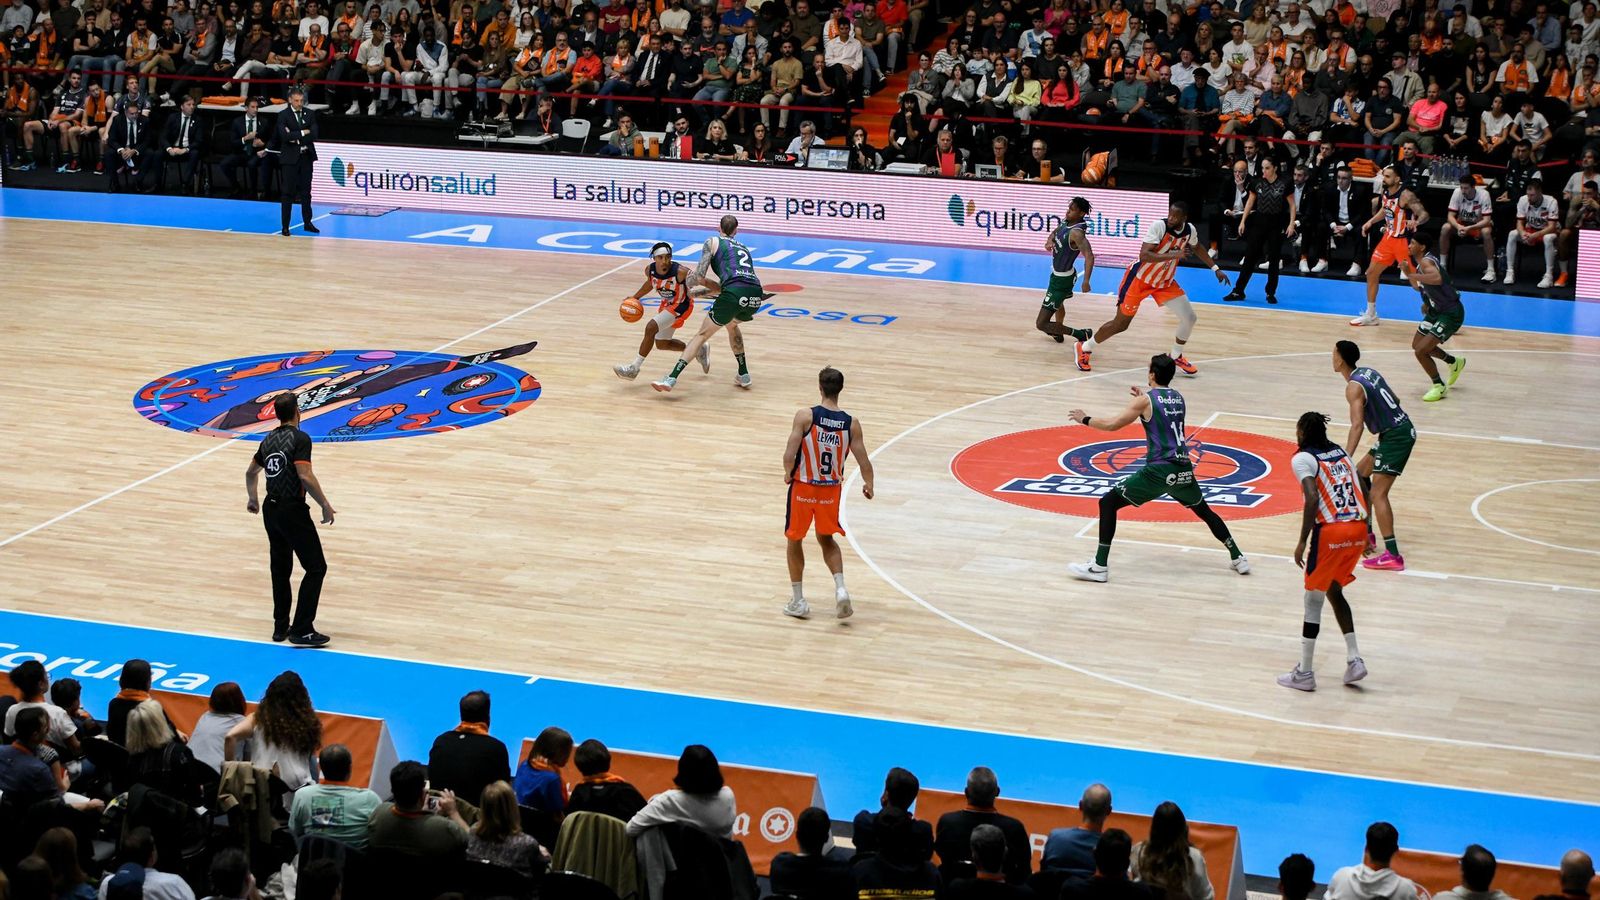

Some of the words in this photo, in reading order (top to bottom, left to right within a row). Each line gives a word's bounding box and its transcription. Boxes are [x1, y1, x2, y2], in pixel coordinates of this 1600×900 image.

[354, 170, 497, 196] quirónsalud
[552, 177, 577, 200] La
[585, 180, 646, 206] salud
[657, 187, 755, 212] persona
[763, 194, 776, 213] a
[785, 196, 886, 221] persona
[408, 223, 493, 243] A
[975, 208, 1140, 238] quirónalud
[737, 249, 752, 268] 2
[1379, 387, 1398, 410] 0
[817, 431, 840, 445] LEYMA
[266, 458, 281, 472] 43
[820, 451, 833, 476] 9
[1333, 482, 1358, 509] 33
